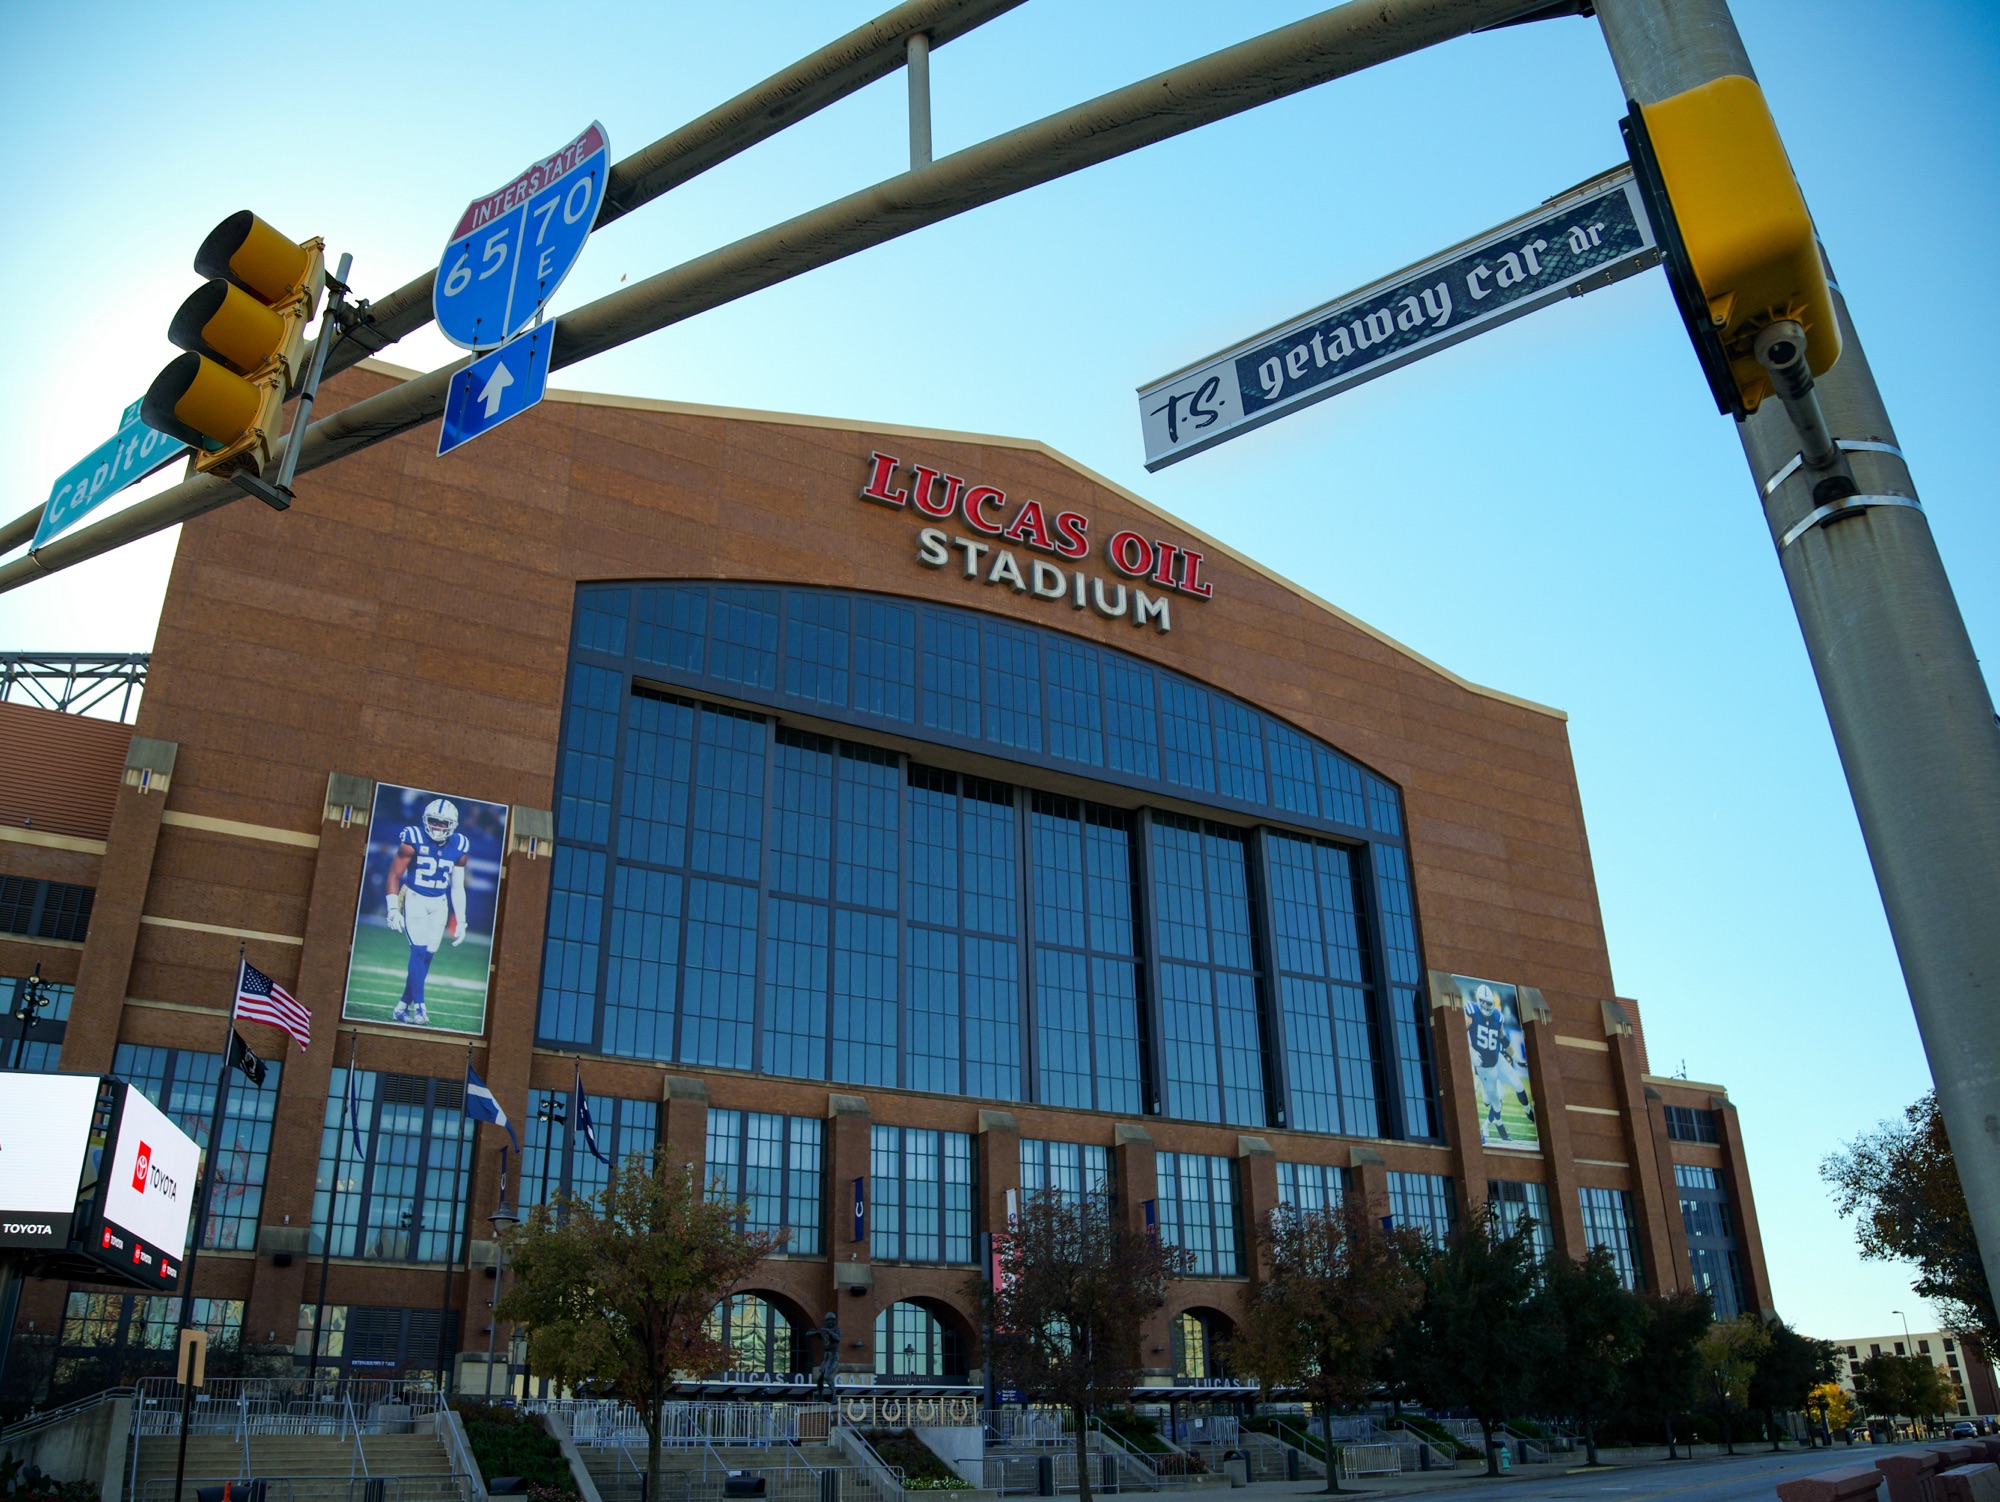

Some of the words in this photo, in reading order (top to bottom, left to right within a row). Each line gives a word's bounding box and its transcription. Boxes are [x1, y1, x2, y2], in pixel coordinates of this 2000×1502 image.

[472, 138, 586, 229] INTERSTATE
[533, 176, 593, 247] 70
[443, 228, 509, 297] 65
[537, 246, 556, 280] E
[1150, 376, 1225, 443] T.S.
[1258, 281, 1453, 400] getaway
[1465, 238, 1547, 300] car
[1568, 222, 1605, 255] dr
[859, 450, 1090, 563] LUCAS
[1105, 529, 1213, 602] OIL
[916, 527, 1171, 635] STADIUM
[414, 855, 455, 890] 23
[1476, 1023, 1499, 1051] 56
[150, 1164, 178, 1202] TOYOTA
[3, 1223, 53, 1235] TOYOTA
[723, 1371, 785, 1384] LUCAS
[834, 1374, 878, 1385] GATE
